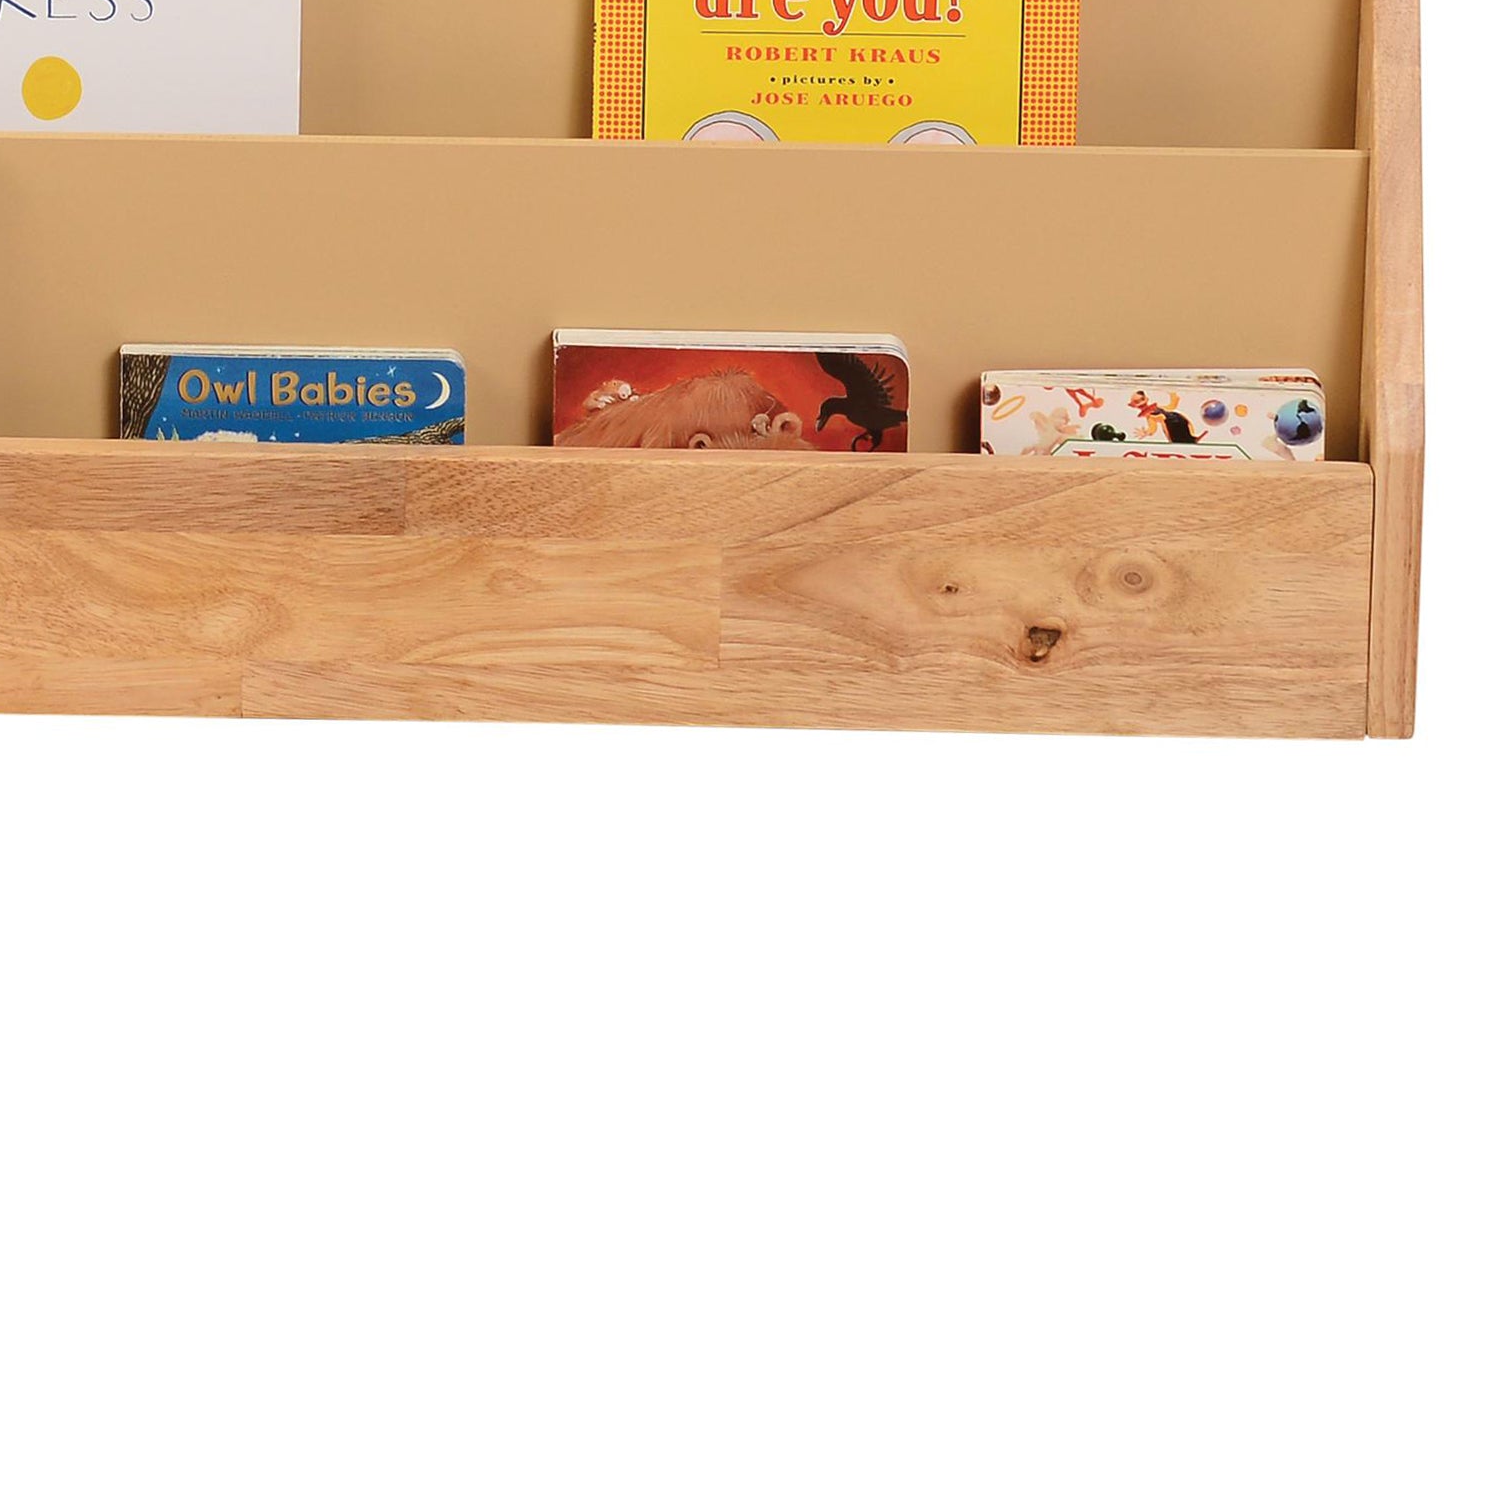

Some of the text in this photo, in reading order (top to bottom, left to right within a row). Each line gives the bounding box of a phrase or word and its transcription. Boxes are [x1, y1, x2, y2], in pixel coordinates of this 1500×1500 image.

[726, 46, 941, 64] ROBERT KRAUS
[782, 75, 882, 87] pictures by
[751, 92, 913, 107] JOSE ARUEGO
[178, 368, 417, 407] Owl Babies
